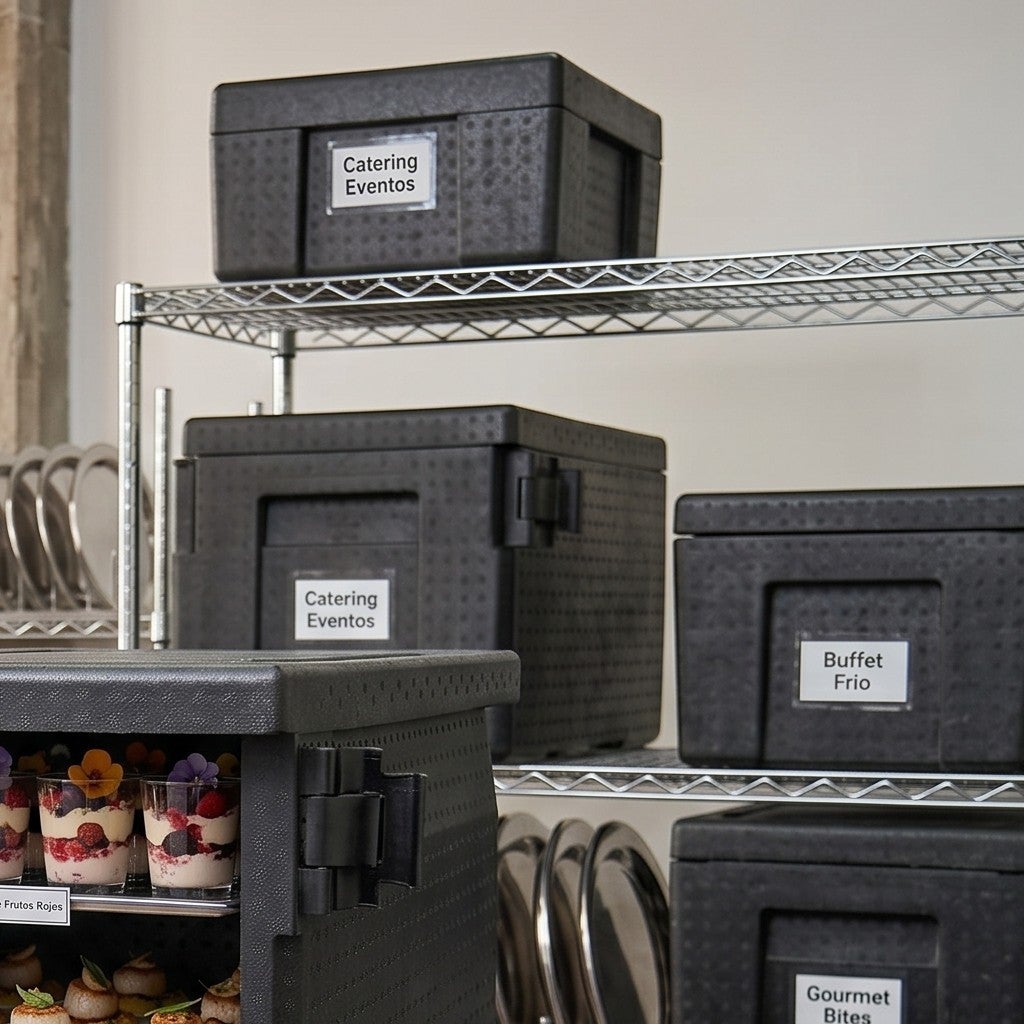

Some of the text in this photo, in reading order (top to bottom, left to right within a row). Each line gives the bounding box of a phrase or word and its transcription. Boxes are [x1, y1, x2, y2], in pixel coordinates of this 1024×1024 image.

[343, 153, 418, 173] Catering
[345, 177, 416, 196] Eventos
[305, 590, 378, 610] Catering
[307, 612, 375, 628] Eventos
[824, 651, 883, 668] Buffet
[834, 673, 871, 691] Frio
[4, 899, 34, 910] Frutos
[36, 901, 63, 913] Rojes
[806, 985, 890, 1006] Gourmet
